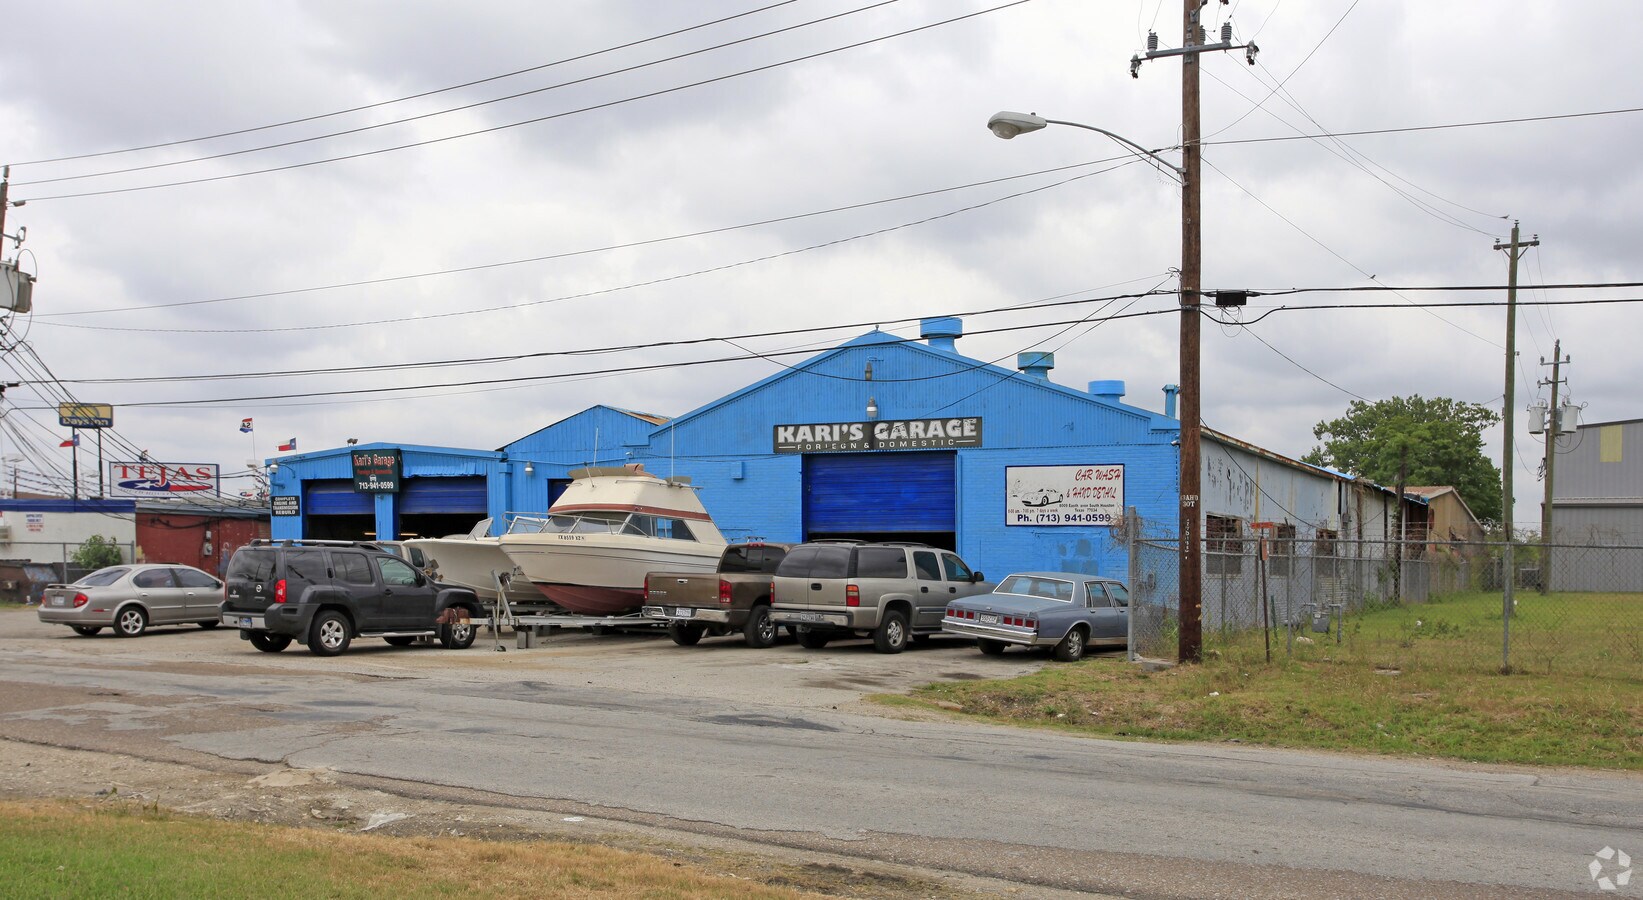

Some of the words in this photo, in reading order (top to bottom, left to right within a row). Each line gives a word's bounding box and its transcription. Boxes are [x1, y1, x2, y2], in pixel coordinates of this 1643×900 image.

[778, 424, 863, 442] KARI'S
[874, 418, 977, 439] GARAGE
[797, 442, 857, 450] FORIEGN
[879, 438, 954, 448] DOMESTIC
[373, 454, 395, 467] Garage
[113, 465, 212, 487] TEJAS
[1075, 468, 1093, 481] CAR
[1095, 468, 1121, 480] WASH
[358, 481, 394, 490] 713-941-0599
[1072, 486, 1091, 499] HAND
[1092, 486, 1117, 499] DETAIL
[1017, 514, 1032, 522] Ph.
[1036, 513, 1061, 523] (713)
[1064, 513, 1111, 522] 941-0599
